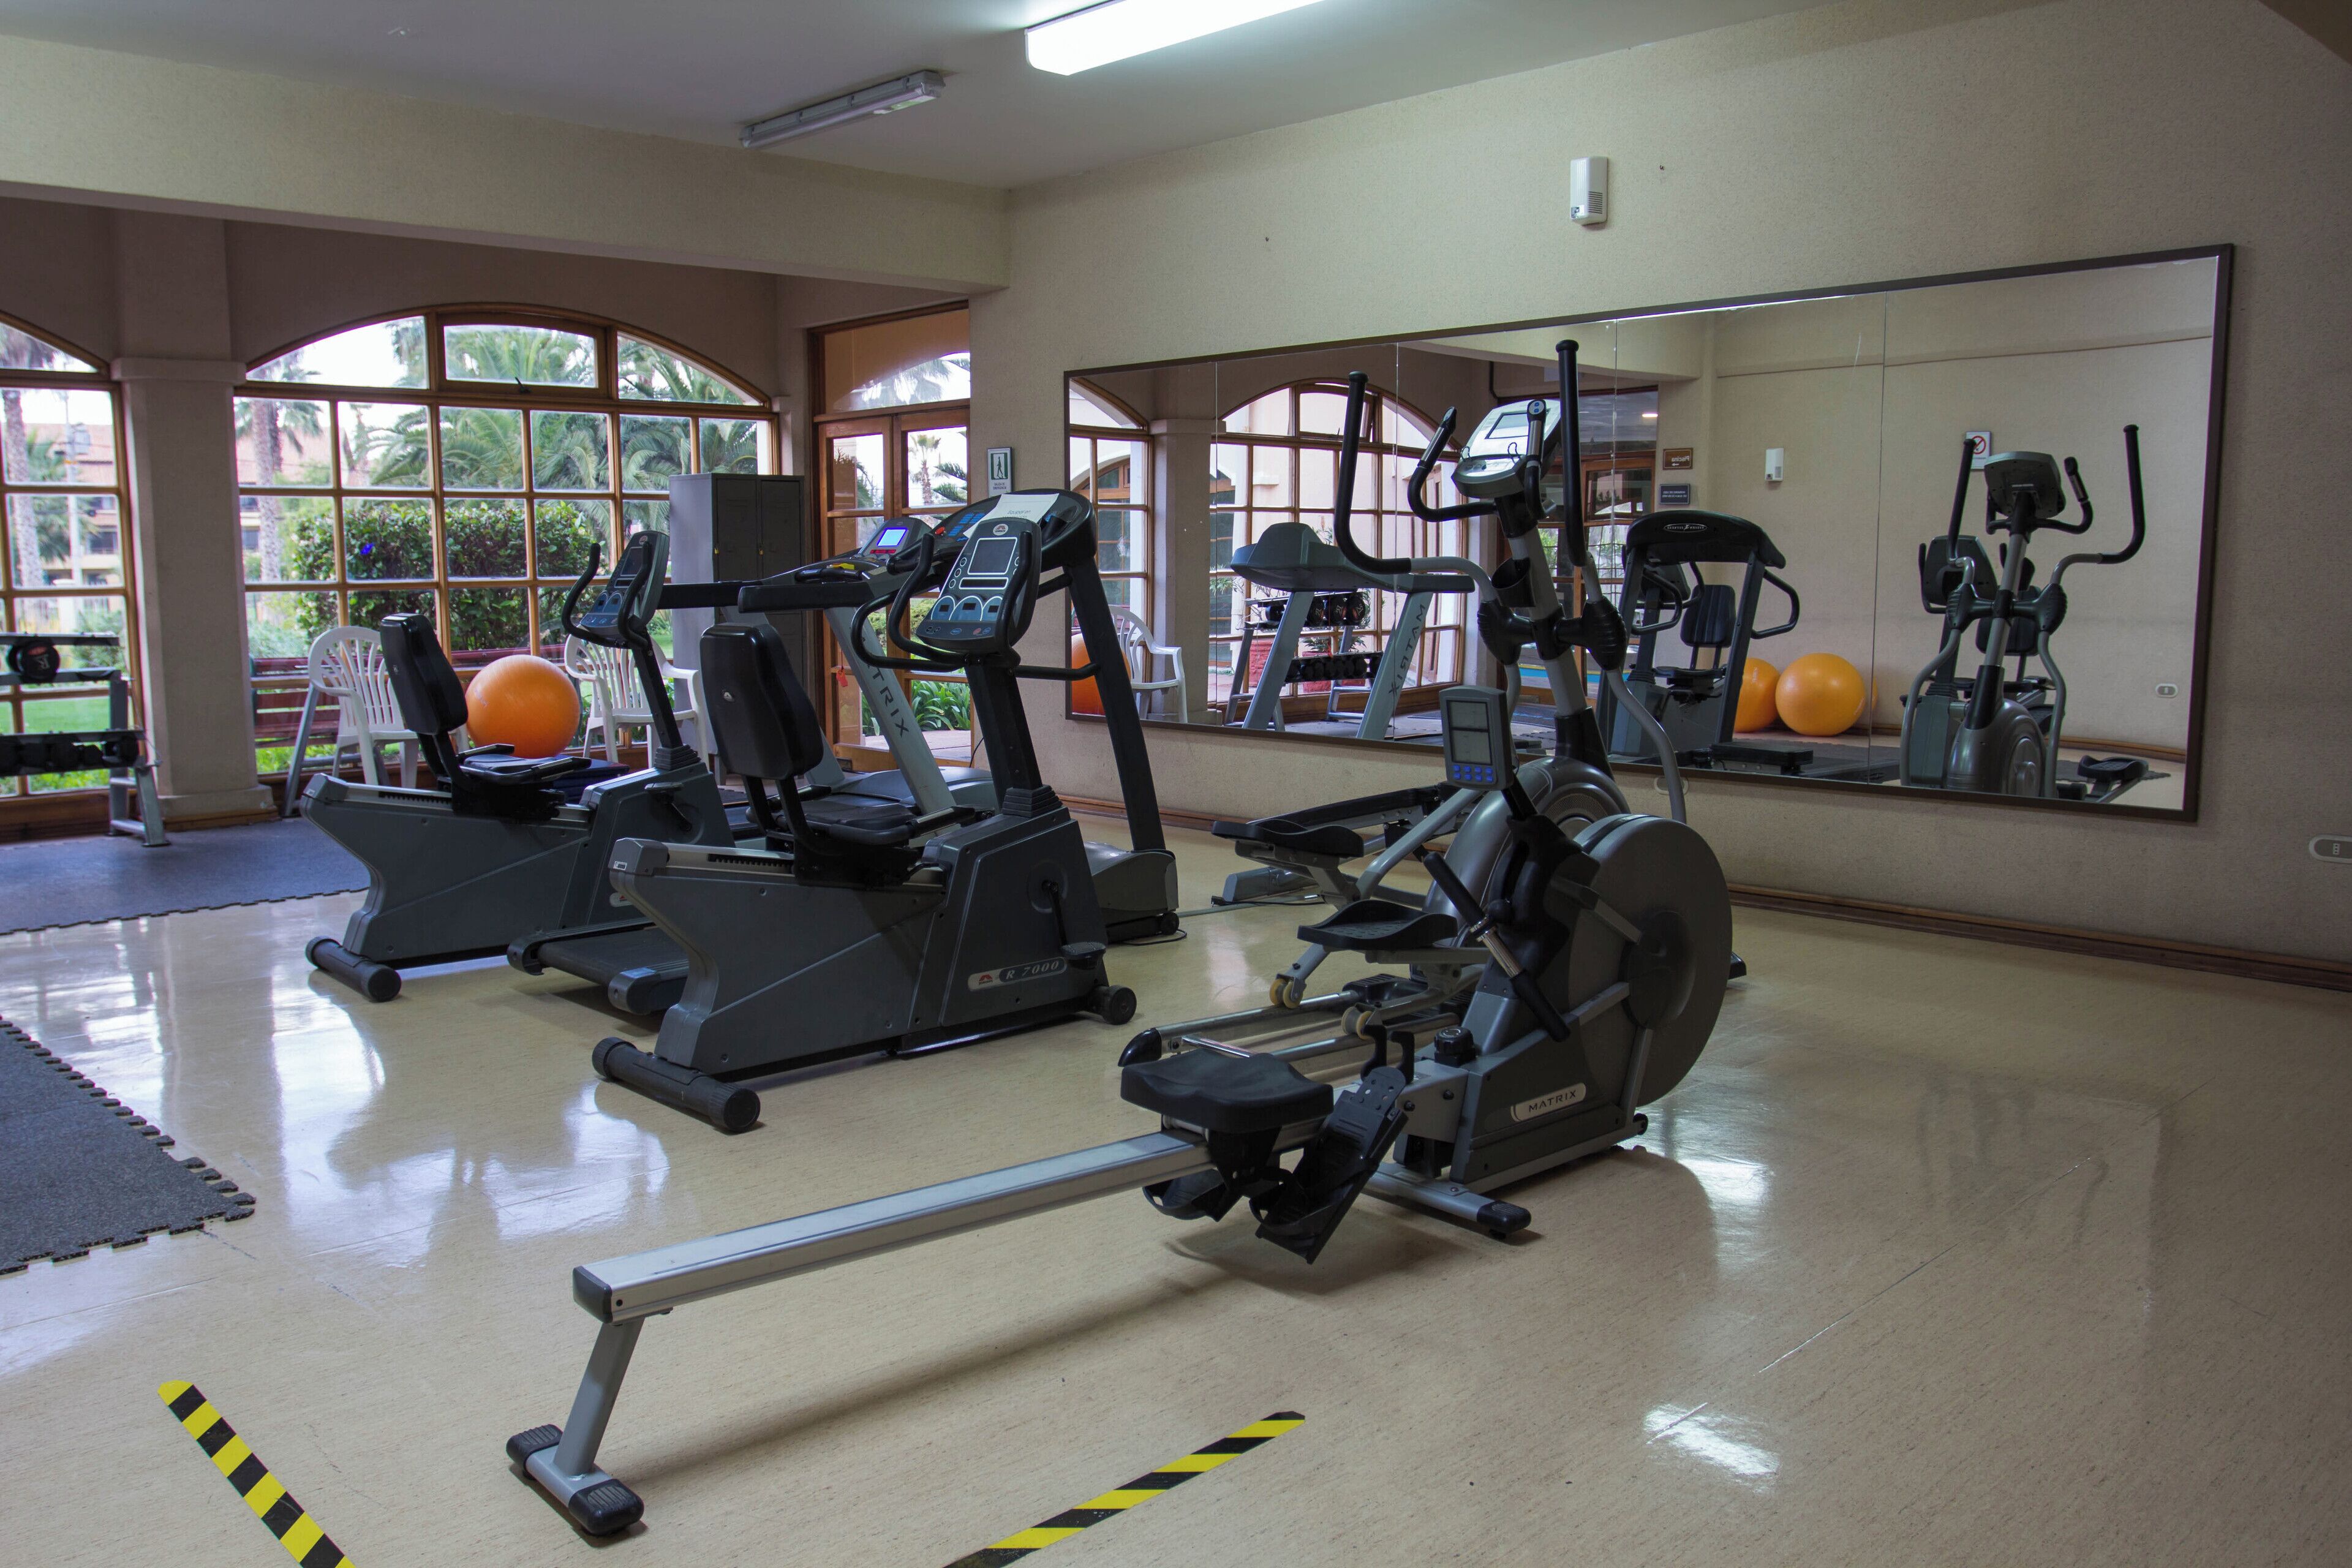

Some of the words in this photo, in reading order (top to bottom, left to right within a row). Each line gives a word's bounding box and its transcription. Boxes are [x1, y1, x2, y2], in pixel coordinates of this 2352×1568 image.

[1006, 970, 1015, 979] R
[1022, 960, 1059, 976] 7000
[1529, 1090, 1577, 1112] MATRIX
